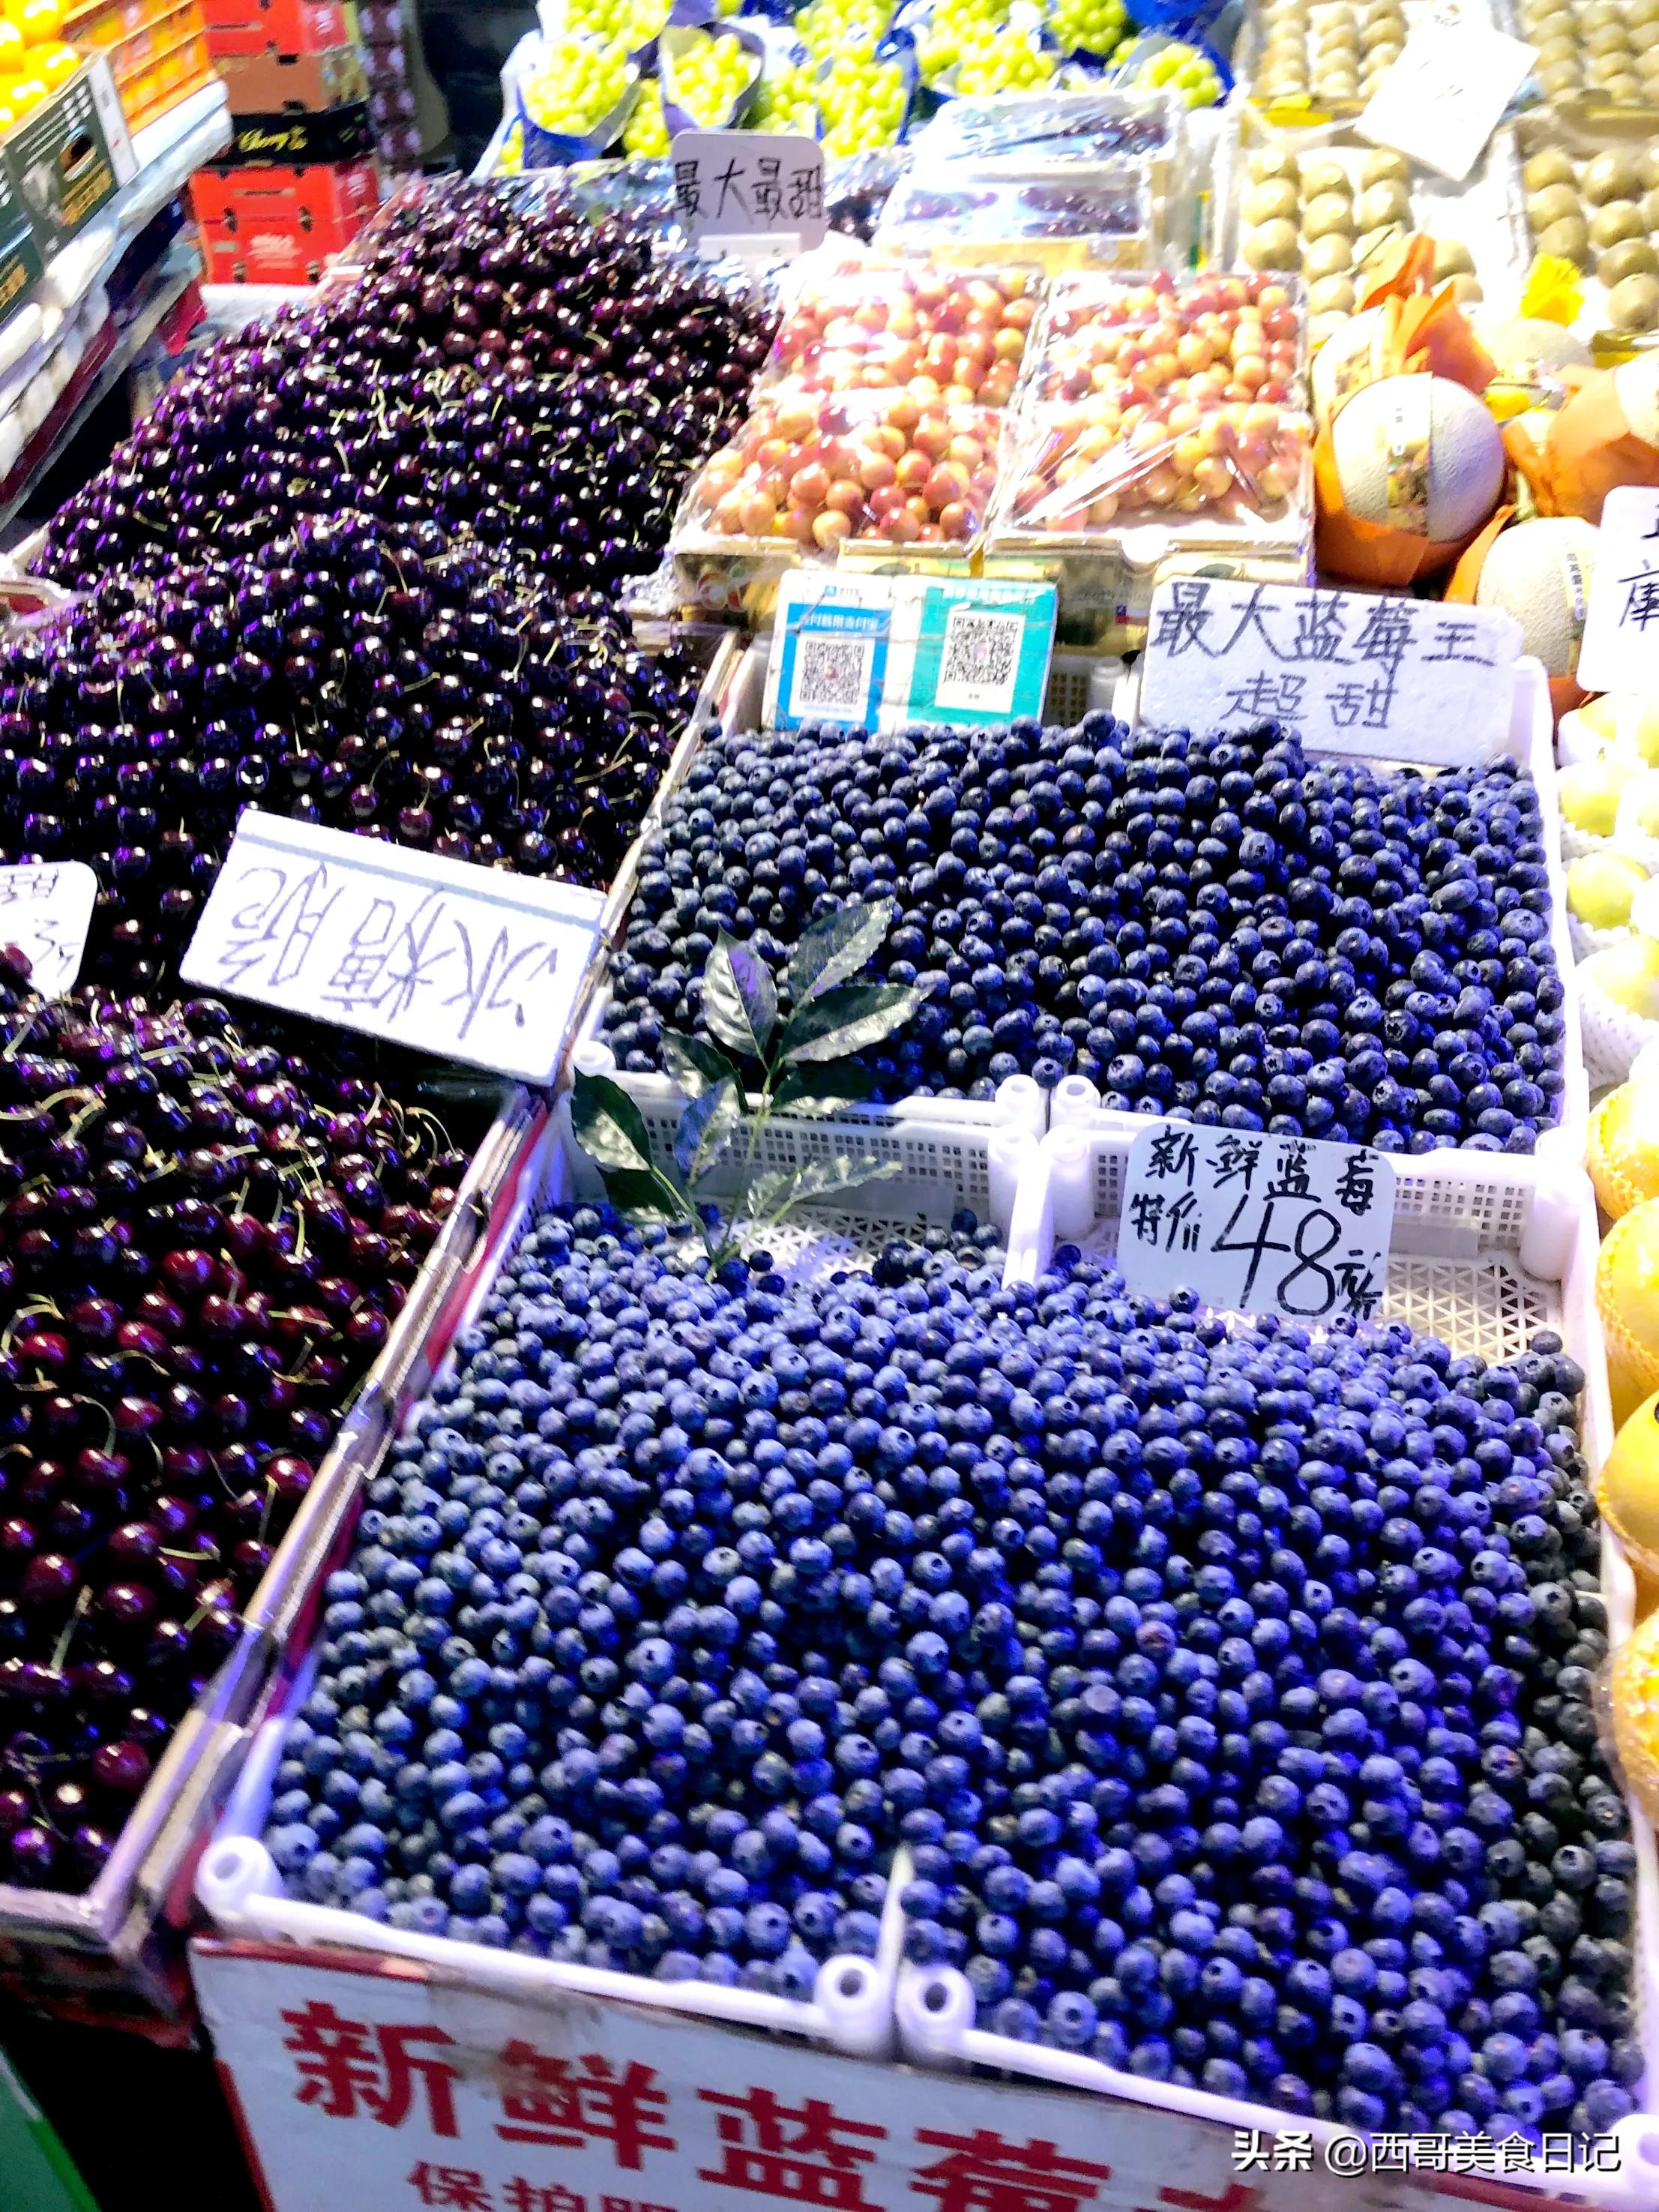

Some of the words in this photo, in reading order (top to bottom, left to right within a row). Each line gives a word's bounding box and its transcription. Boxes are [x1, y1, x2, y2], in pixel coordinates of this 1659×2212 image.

[674, 156, 822, 225] 最大最甜
[1150, 582, 1496, 674] 最大蓝莓王
[1220, 673, 1399, 729] 超甜
[1145, 1125, 1379, 1216] 新鲜蓝莓
[280, 2000, 1267, 2212] 新鲜蓝莓
[406, 2161, 678, 2212] 保护
